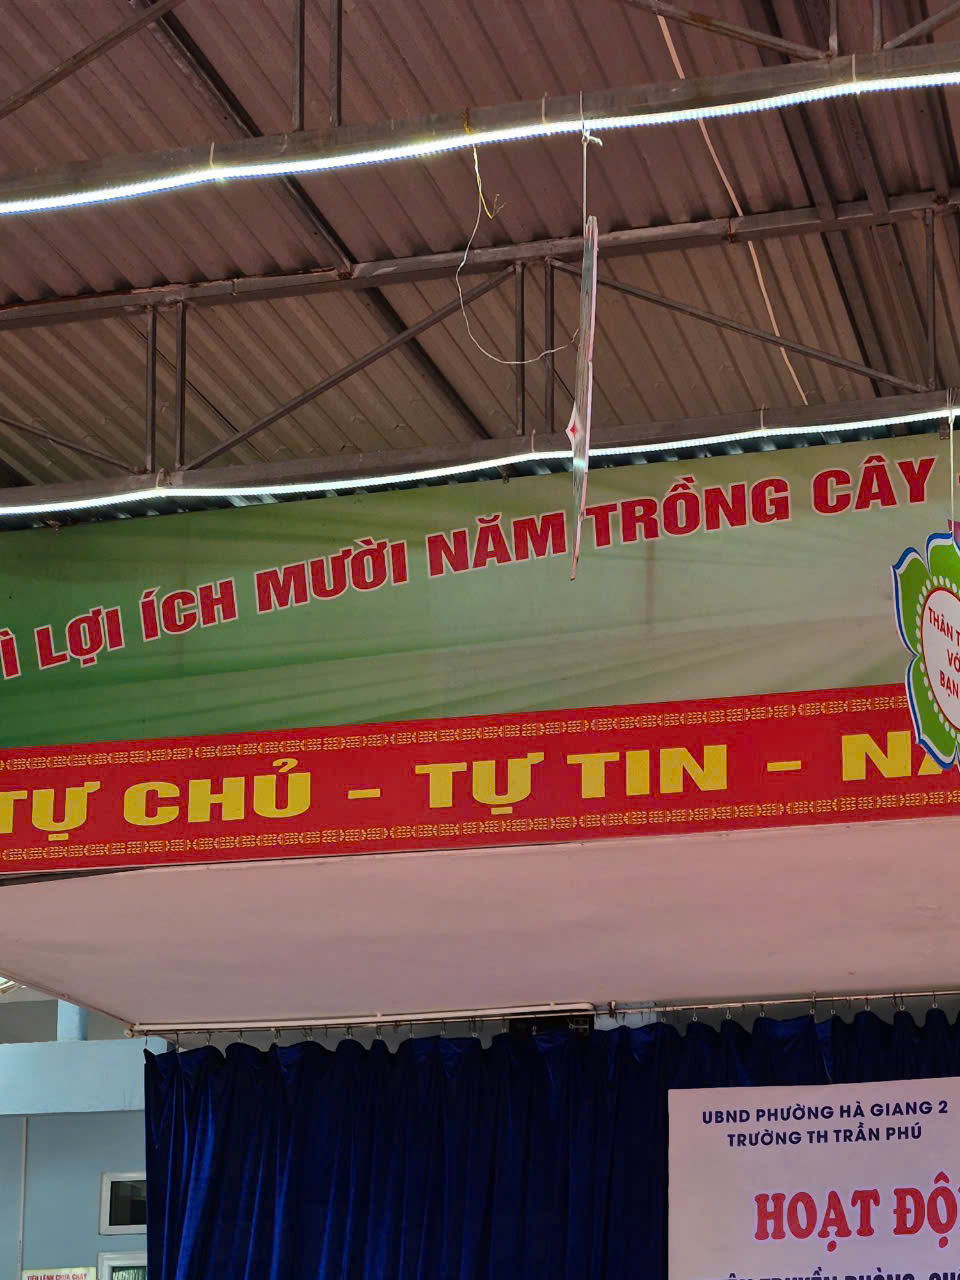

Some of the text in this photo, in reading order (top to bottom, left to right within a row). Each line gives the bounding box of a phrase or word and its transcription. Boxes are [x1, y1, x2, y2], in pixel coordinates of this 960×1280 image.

[36, 608, 123, 668] LỢI
[141, 580, 236, 640] ÍCH
[255, 538, 407, 612] MƯỜI
[427, 512, 566, 577] NĂM
[585, 476, 789, 547] TRỒNG
[812, 455, 935, 514] CÂY
[928, 607, 954, 642] THÂN
[939, 669, 959, 698] BẠN
[123, 758, 311, 826] CHỦ
[415, 751, 545, 815] TỰ
[567, 746, 728, 799] TIN
[702, 1100, 948, 1125] UBND PHƯỜNG HÀ GIANG 2
[727, 1121, 922, 1147] TRƯỜNG TH TRẦN PHÚ
[754, 1188, 881, 1253] HOẠT
